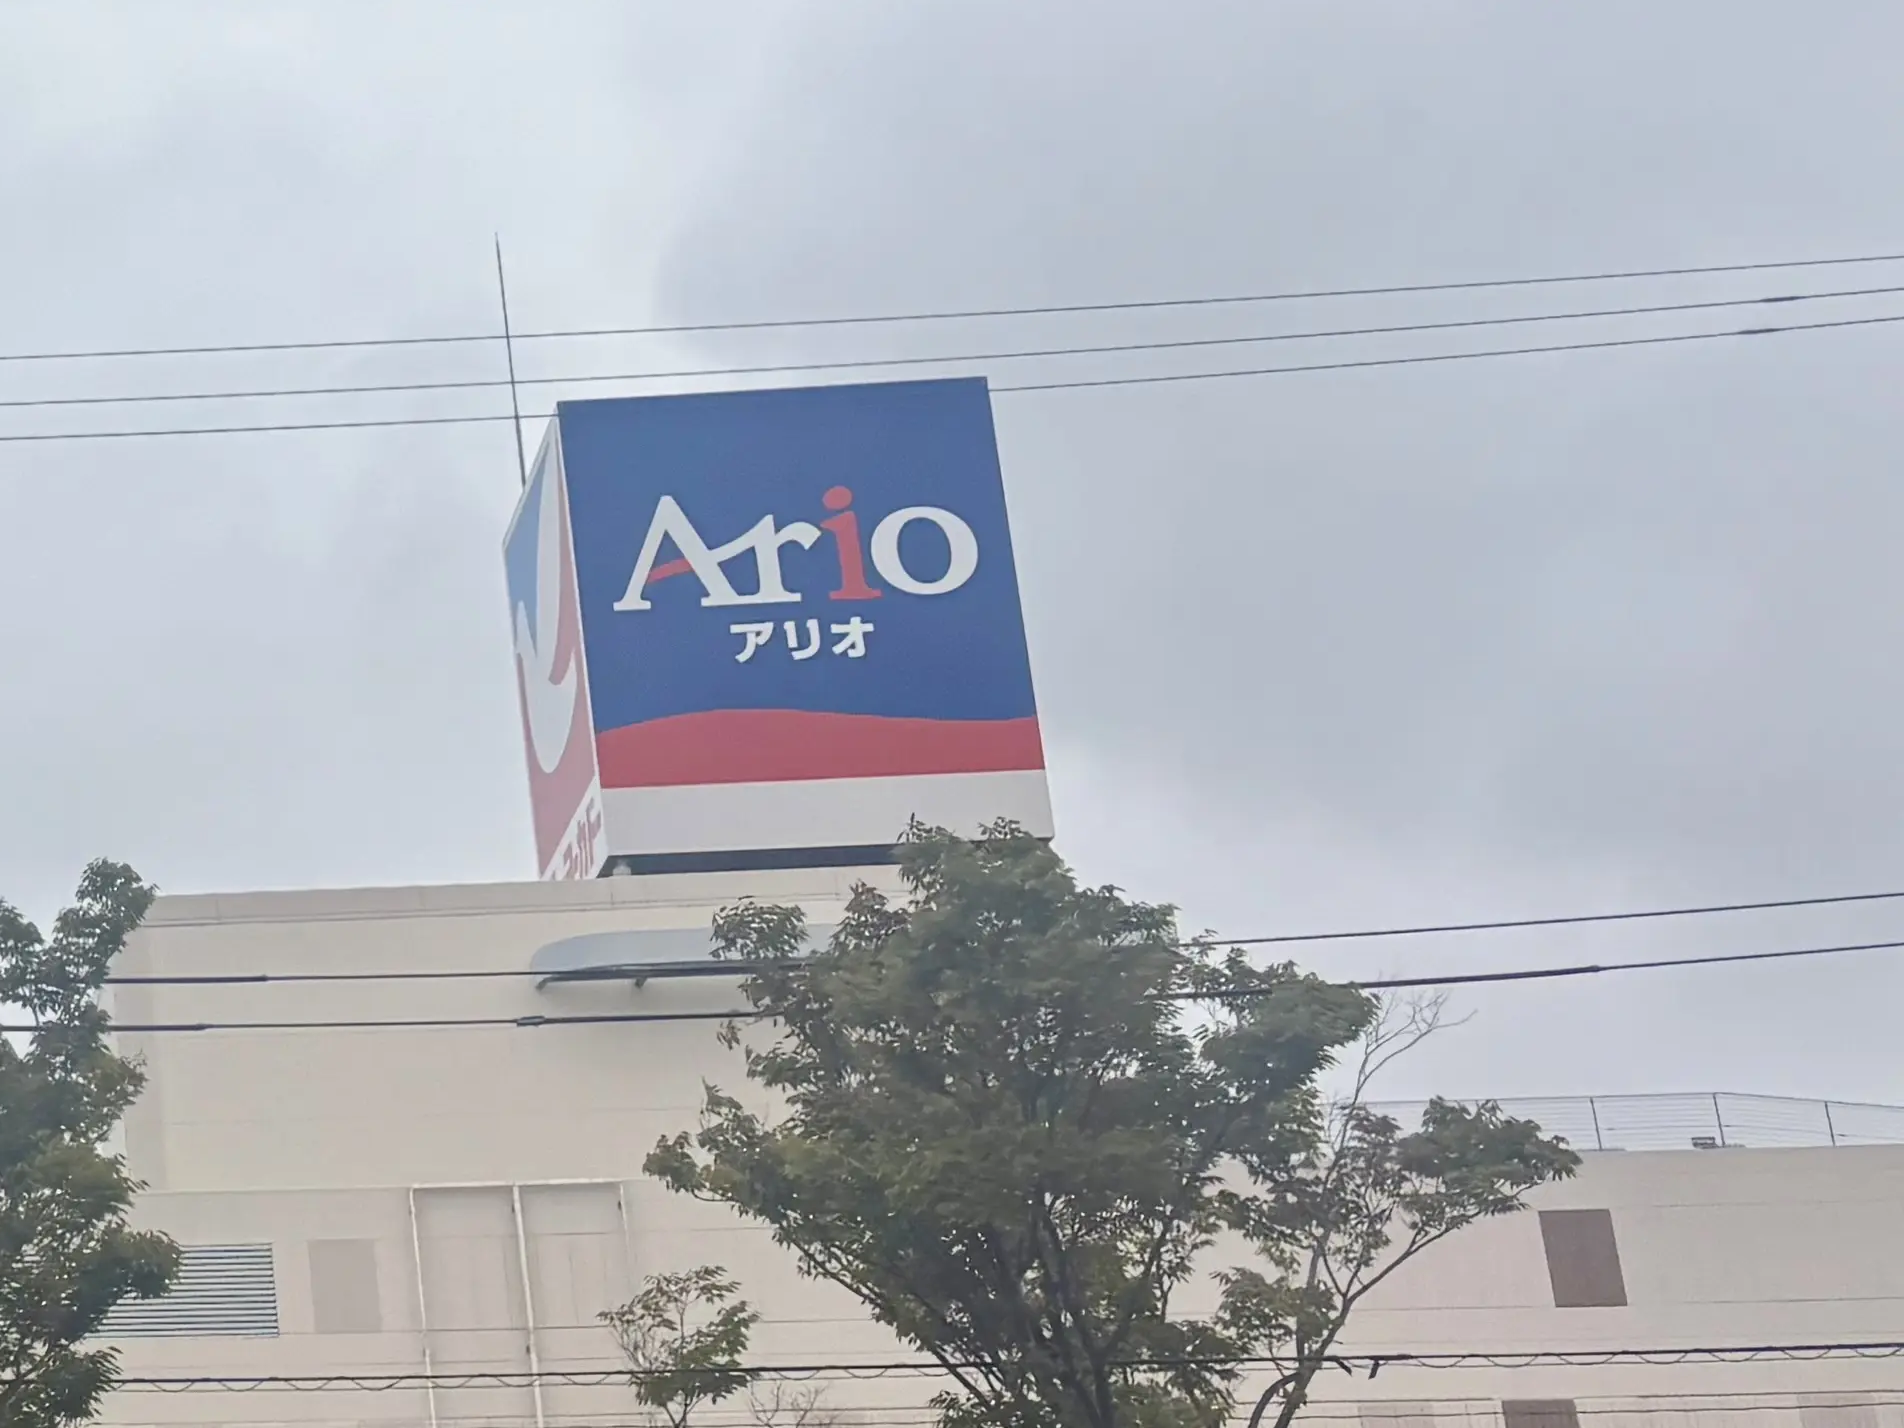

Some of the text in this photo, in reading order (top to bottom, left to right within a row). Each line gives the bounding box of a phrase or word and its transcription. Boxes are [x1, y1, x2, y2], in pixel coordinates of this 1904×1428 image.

[613, 485, 979, 611] Ario
[730, 616, 874, 663] アリオ
